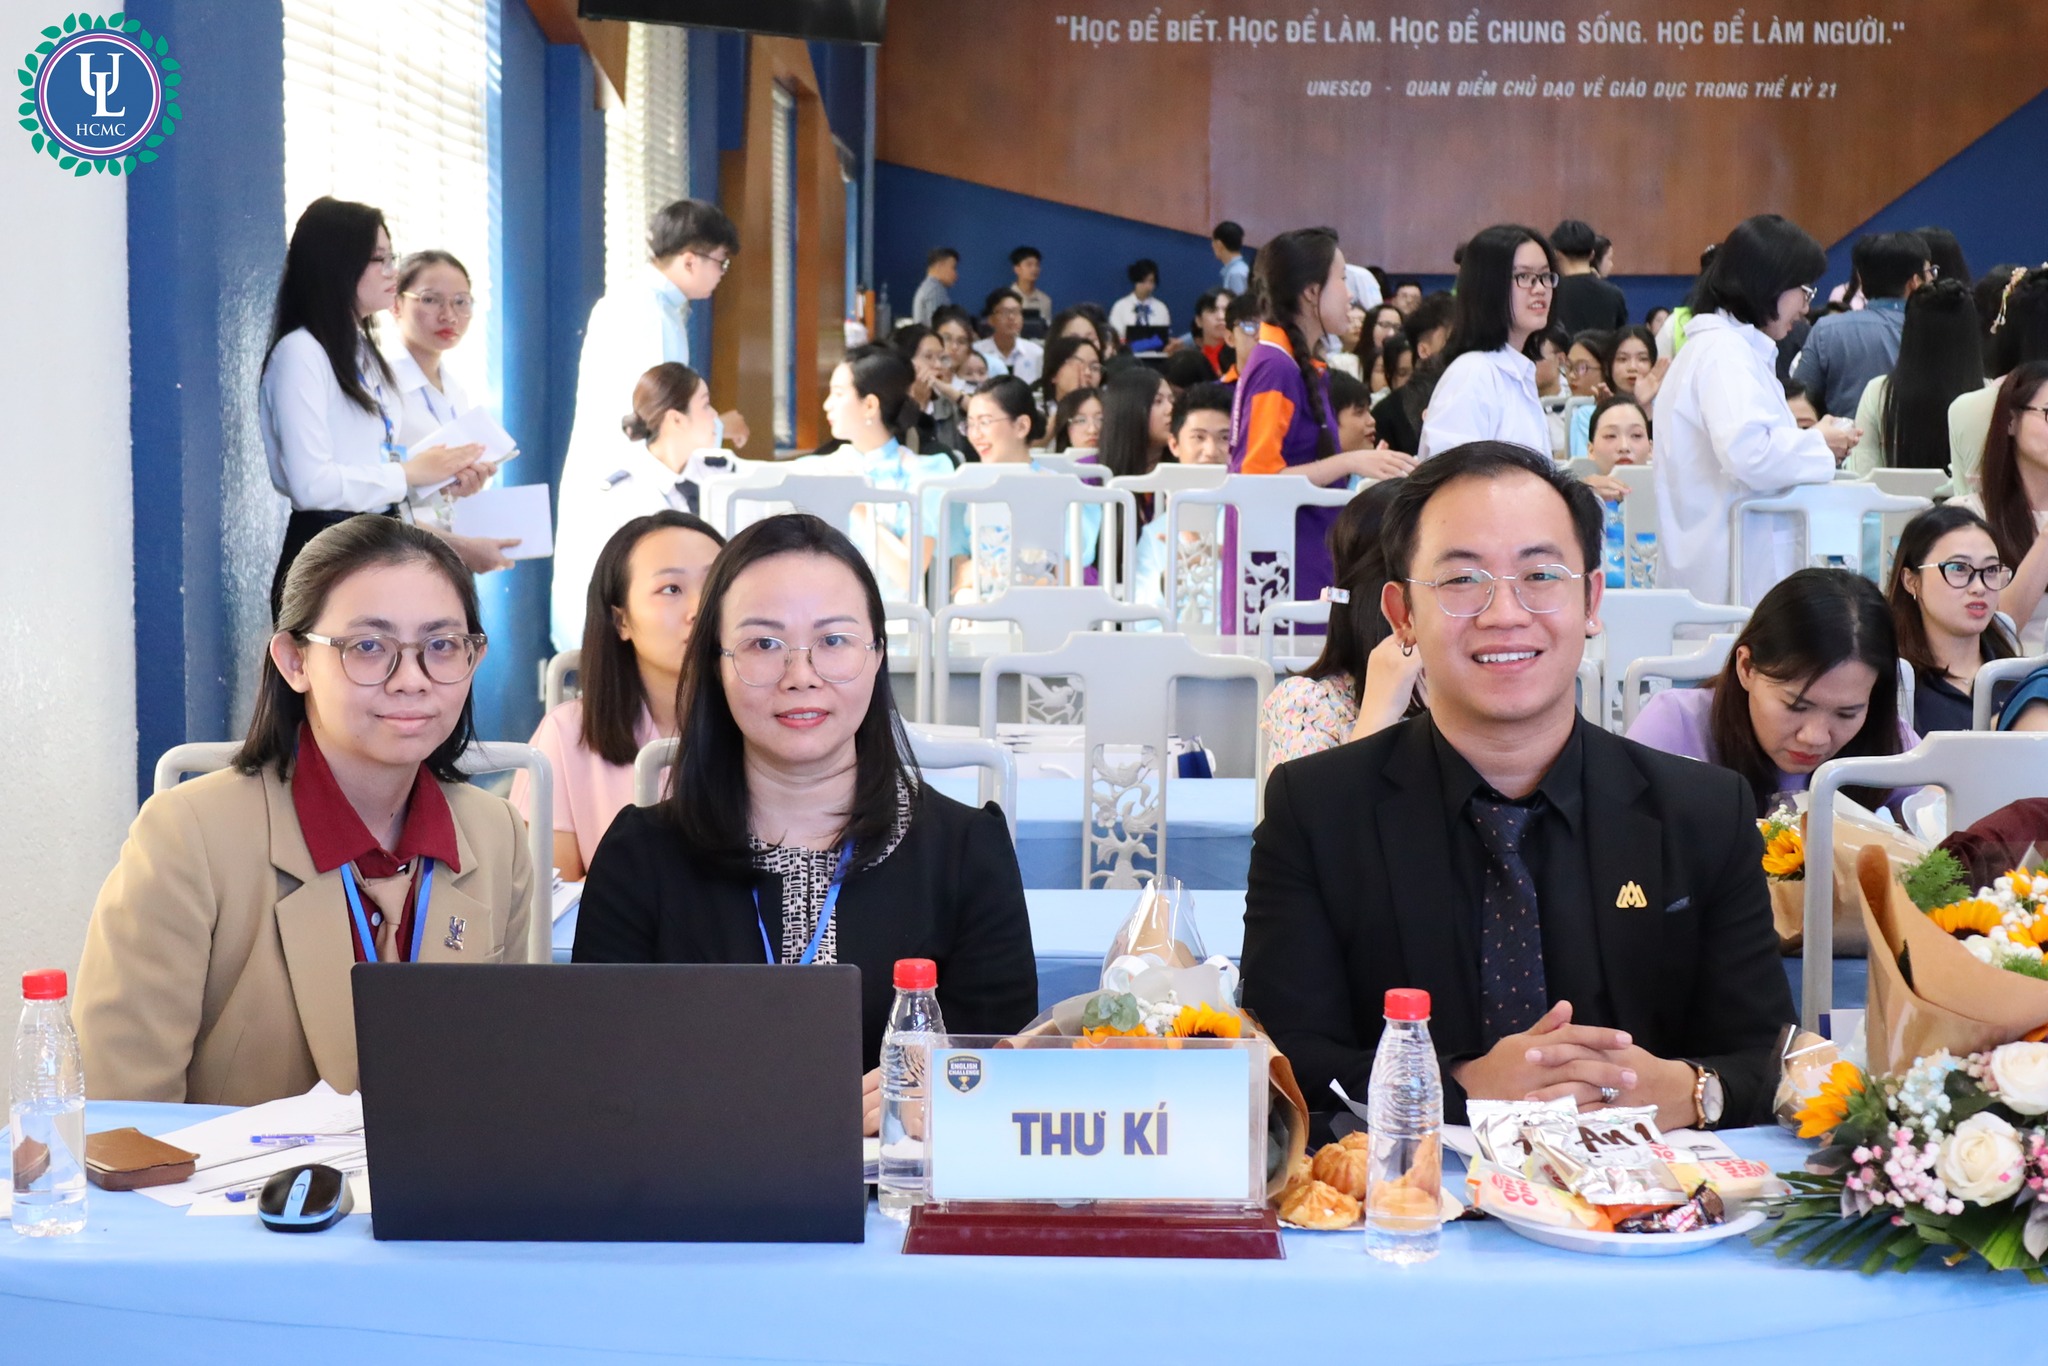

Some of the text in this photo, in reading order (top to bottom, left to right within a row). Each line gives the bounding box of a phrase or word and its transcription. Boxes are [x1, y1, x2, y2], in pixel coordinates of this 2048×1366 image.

[1056, 15, 1121, 49] "HỌC
[1128, 7, 1162, 42] ĐỂ
[1166, 12, 1222, 42] BIẾT.
[1229, 16, 1278, 48] HỌC
[1286, 8, 1319, 43] ĐỂ
[1324, 14, 1382, 43] LÀM.
[1391, 16, 1439, 50] HỌC
[1448, 8, 1480, 44] ĐỂ
[1487, 20, 1566, 44] CHUNG
[1577, 10, 1648, 44] SỐNG.
[1657, 20, 1704, 50] HỌC
[1713, 8, 1745, 45] ĐỂ
[1752, 15, 1805, 45] LÀM
[1306, 80, 1372, 97] UNESCO
[1405, 80, 1451, 97] QUAN
[1457, 70, 1498, 97] ĐIỂM
[1502, 74, 1538, 97] CHỦ
[1542, 81, 1576, 100] ĐẠO
[1583, 74, 1606, 98] VỀ
[1609, 77, 1647, 98] GIÁO
[1653, 81, 1688, 102] DỤC
[1695, 81, 1749, 99] TRONG
[1754, 74, 1789, 99] THẾ
[1790, 76, 1814, 99] KỶ
[1817, 81, 1837, 99] 21
[950, 1062, 978, 1070] ENGLISH
[1012, 1101, 1168, 1156] THƯ KÍ
